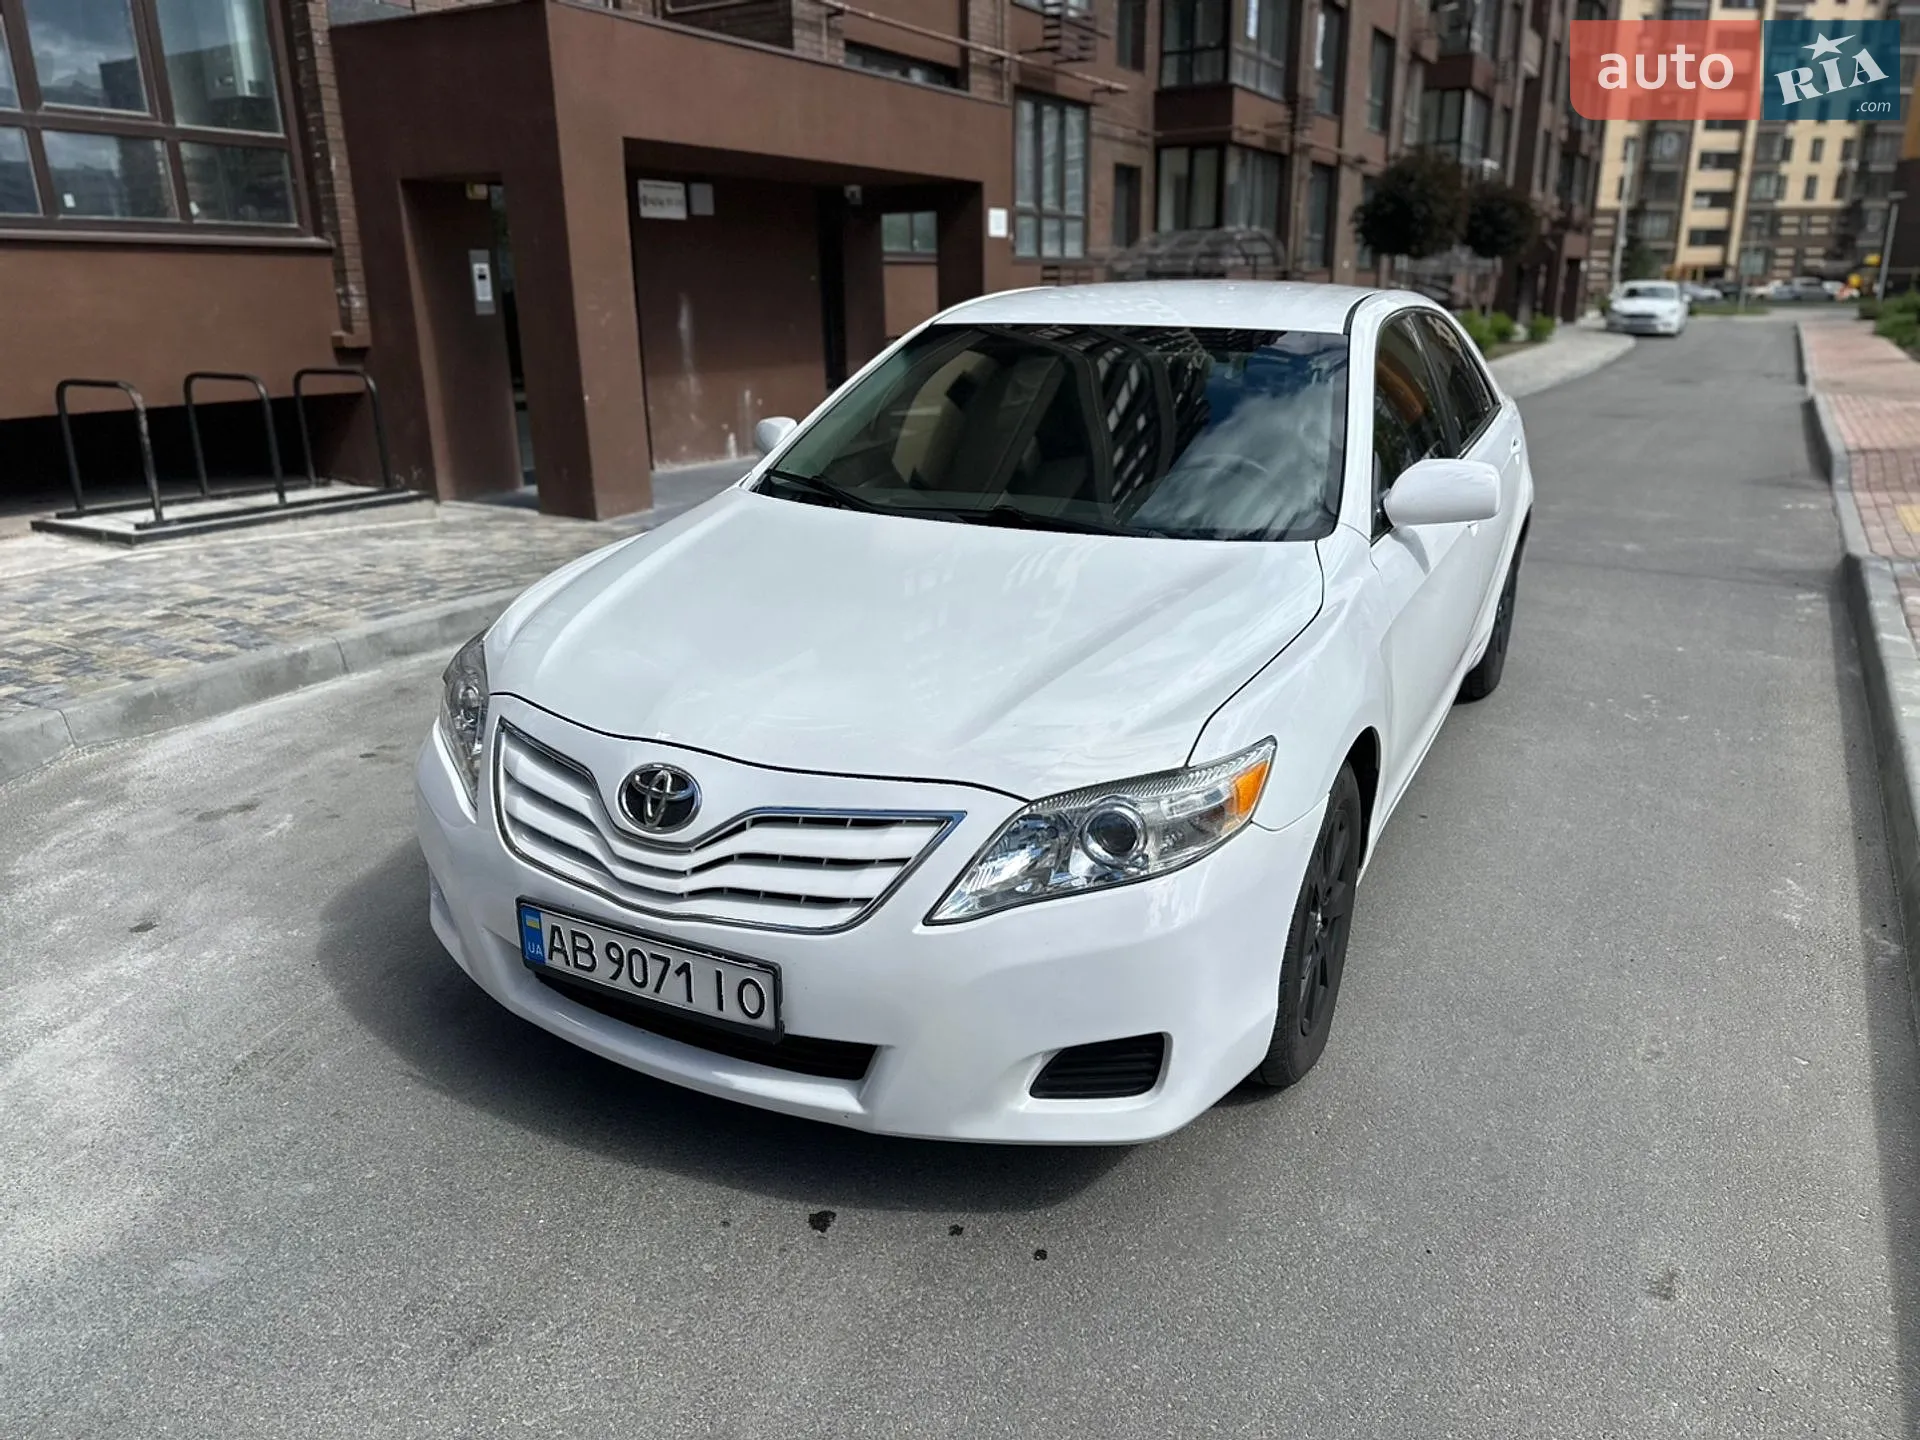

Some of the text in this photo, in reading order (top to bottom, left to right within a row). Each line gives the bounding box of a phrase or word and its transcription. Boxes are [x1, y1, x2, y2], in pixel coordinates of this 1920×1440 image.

[528, 943, 544, 956] UA
[547, 924, 766, 1020] AB 9071 IO
